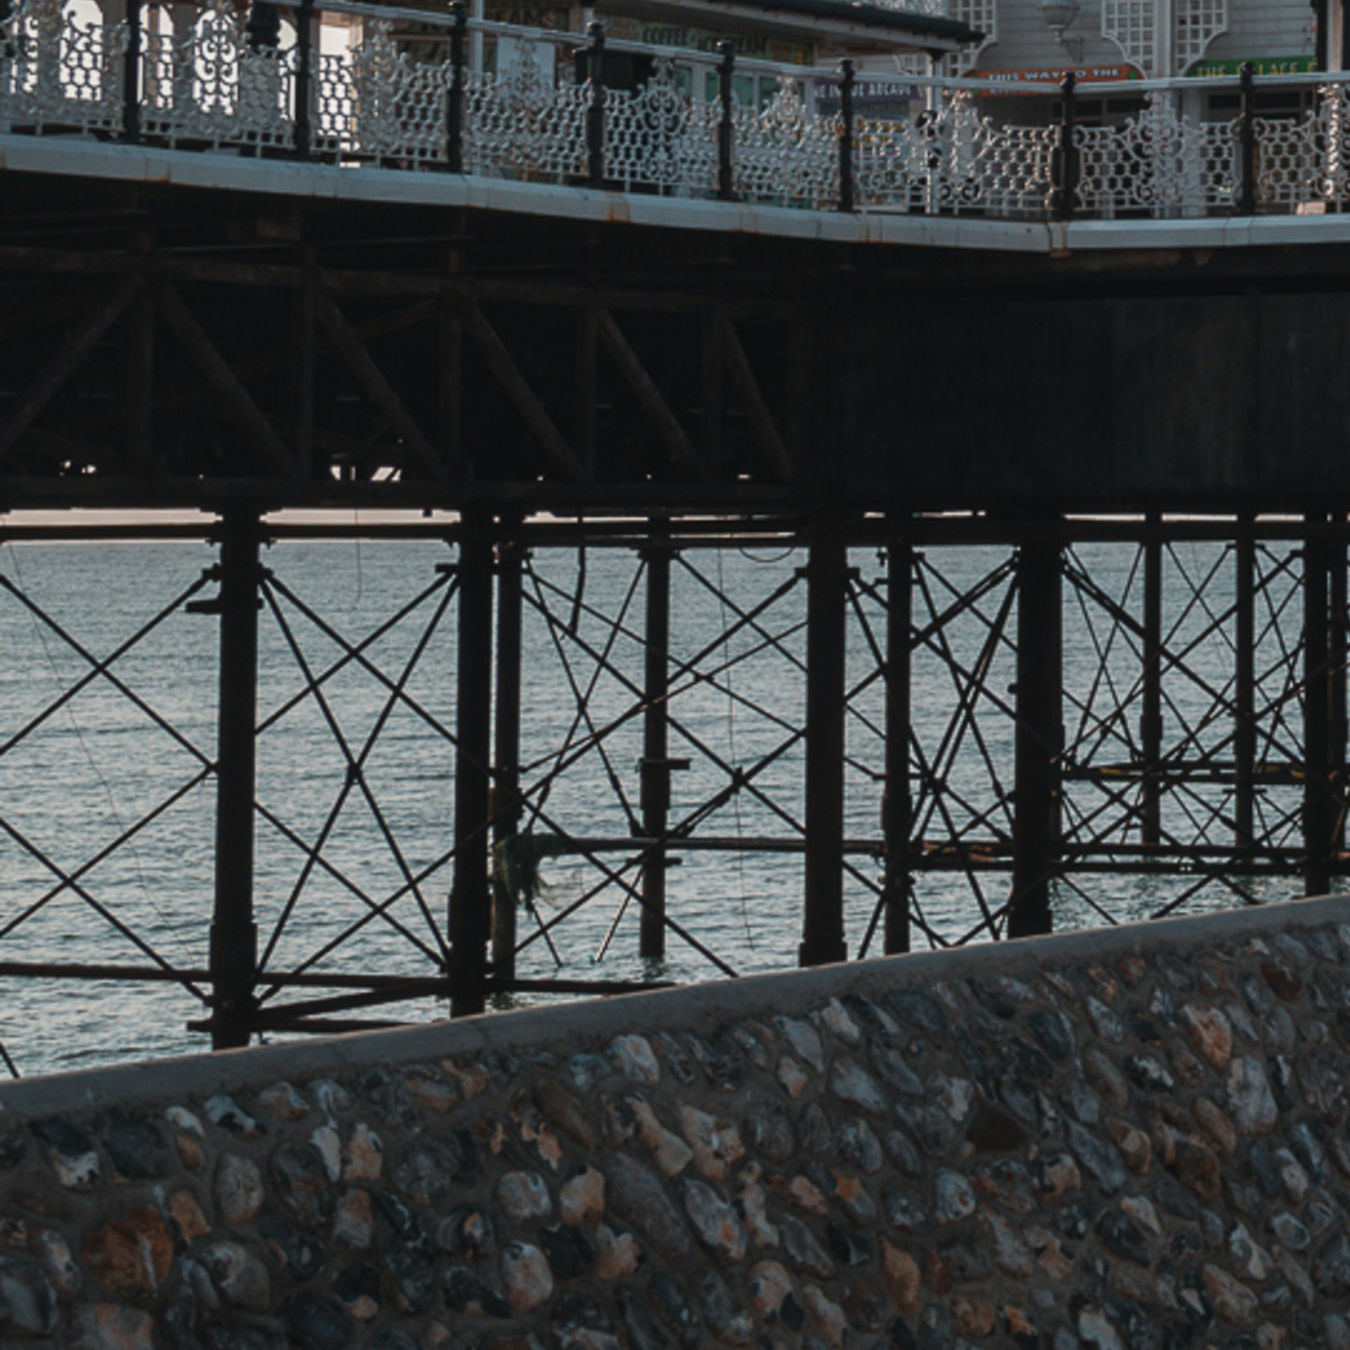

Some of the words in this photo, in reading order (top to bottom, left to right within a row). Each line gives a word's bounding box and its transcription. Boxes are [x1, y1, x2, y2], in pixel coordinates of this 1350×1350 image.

[642, 26, 689, 46] COFFEE
[1024, 70, 1060, 80] WAY
[1092, 68, 1120, 77] THE
